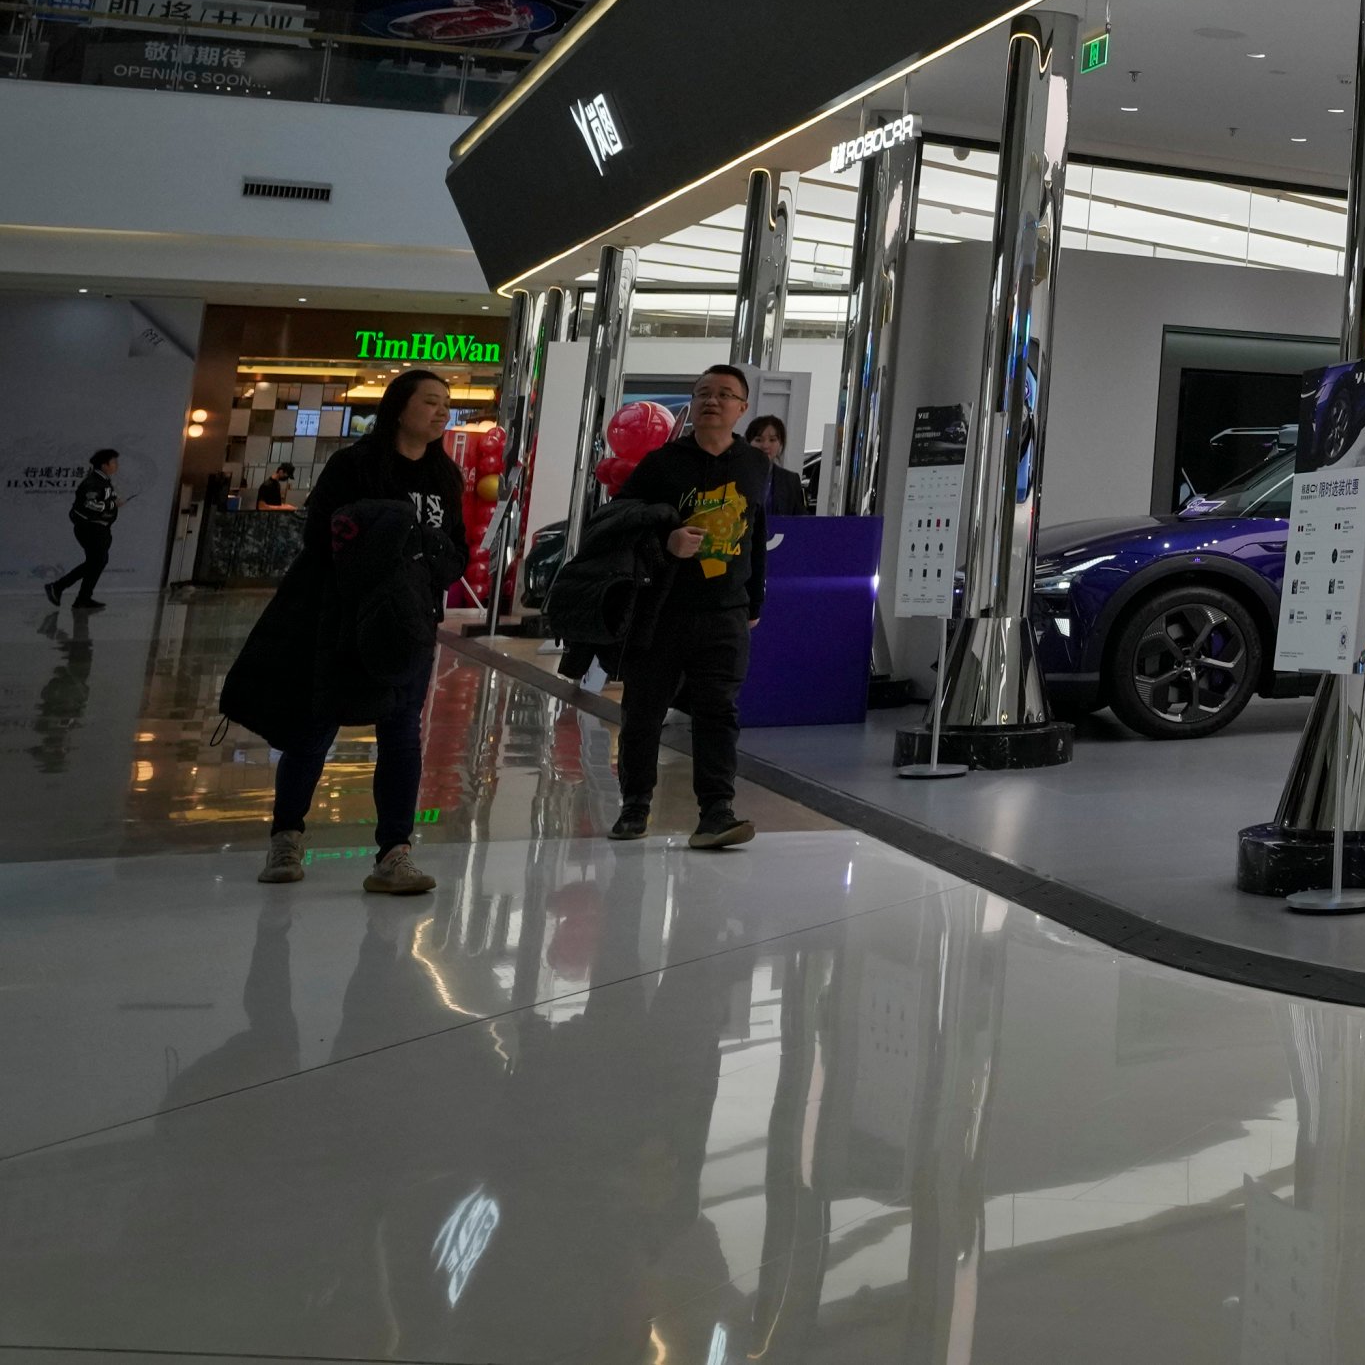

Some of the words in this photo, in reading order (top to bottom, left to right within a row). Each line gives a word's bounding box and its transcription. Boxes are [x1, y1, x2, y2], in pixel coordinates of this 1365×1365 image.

[144, 40, 246, 69] 敬请期待
[113, 63, 197, 84] OPENING
[845, 114, 914, 165] ROBOCAR
[355, 330, 500, 363] TimHoWan
[710, 542, 743, 556] FILA
